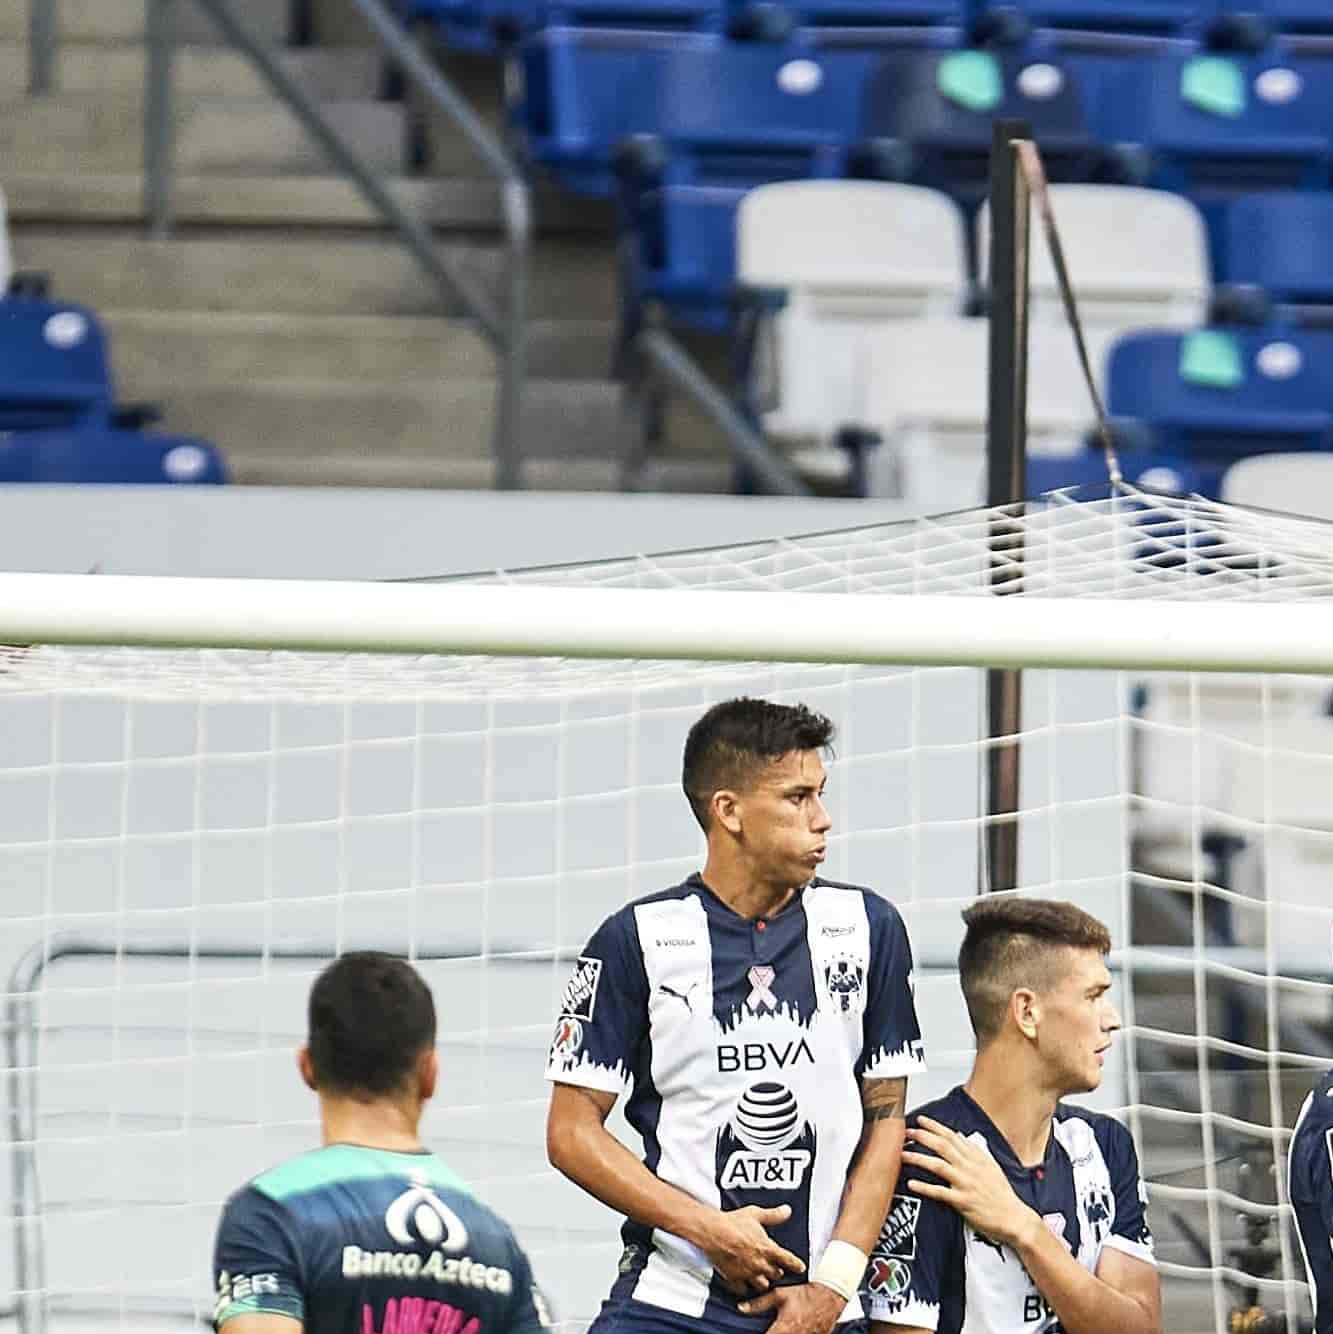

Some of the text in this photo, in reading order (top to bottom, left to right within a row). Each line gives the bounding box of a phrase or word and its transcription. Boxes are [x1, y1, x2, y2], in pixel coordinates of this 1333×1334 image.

[717, 1037, 815, 1073] BBVA
[728, 1157, 803, 1183] AT&T
[343, 1245, 513, 1295] Banco Azteca
